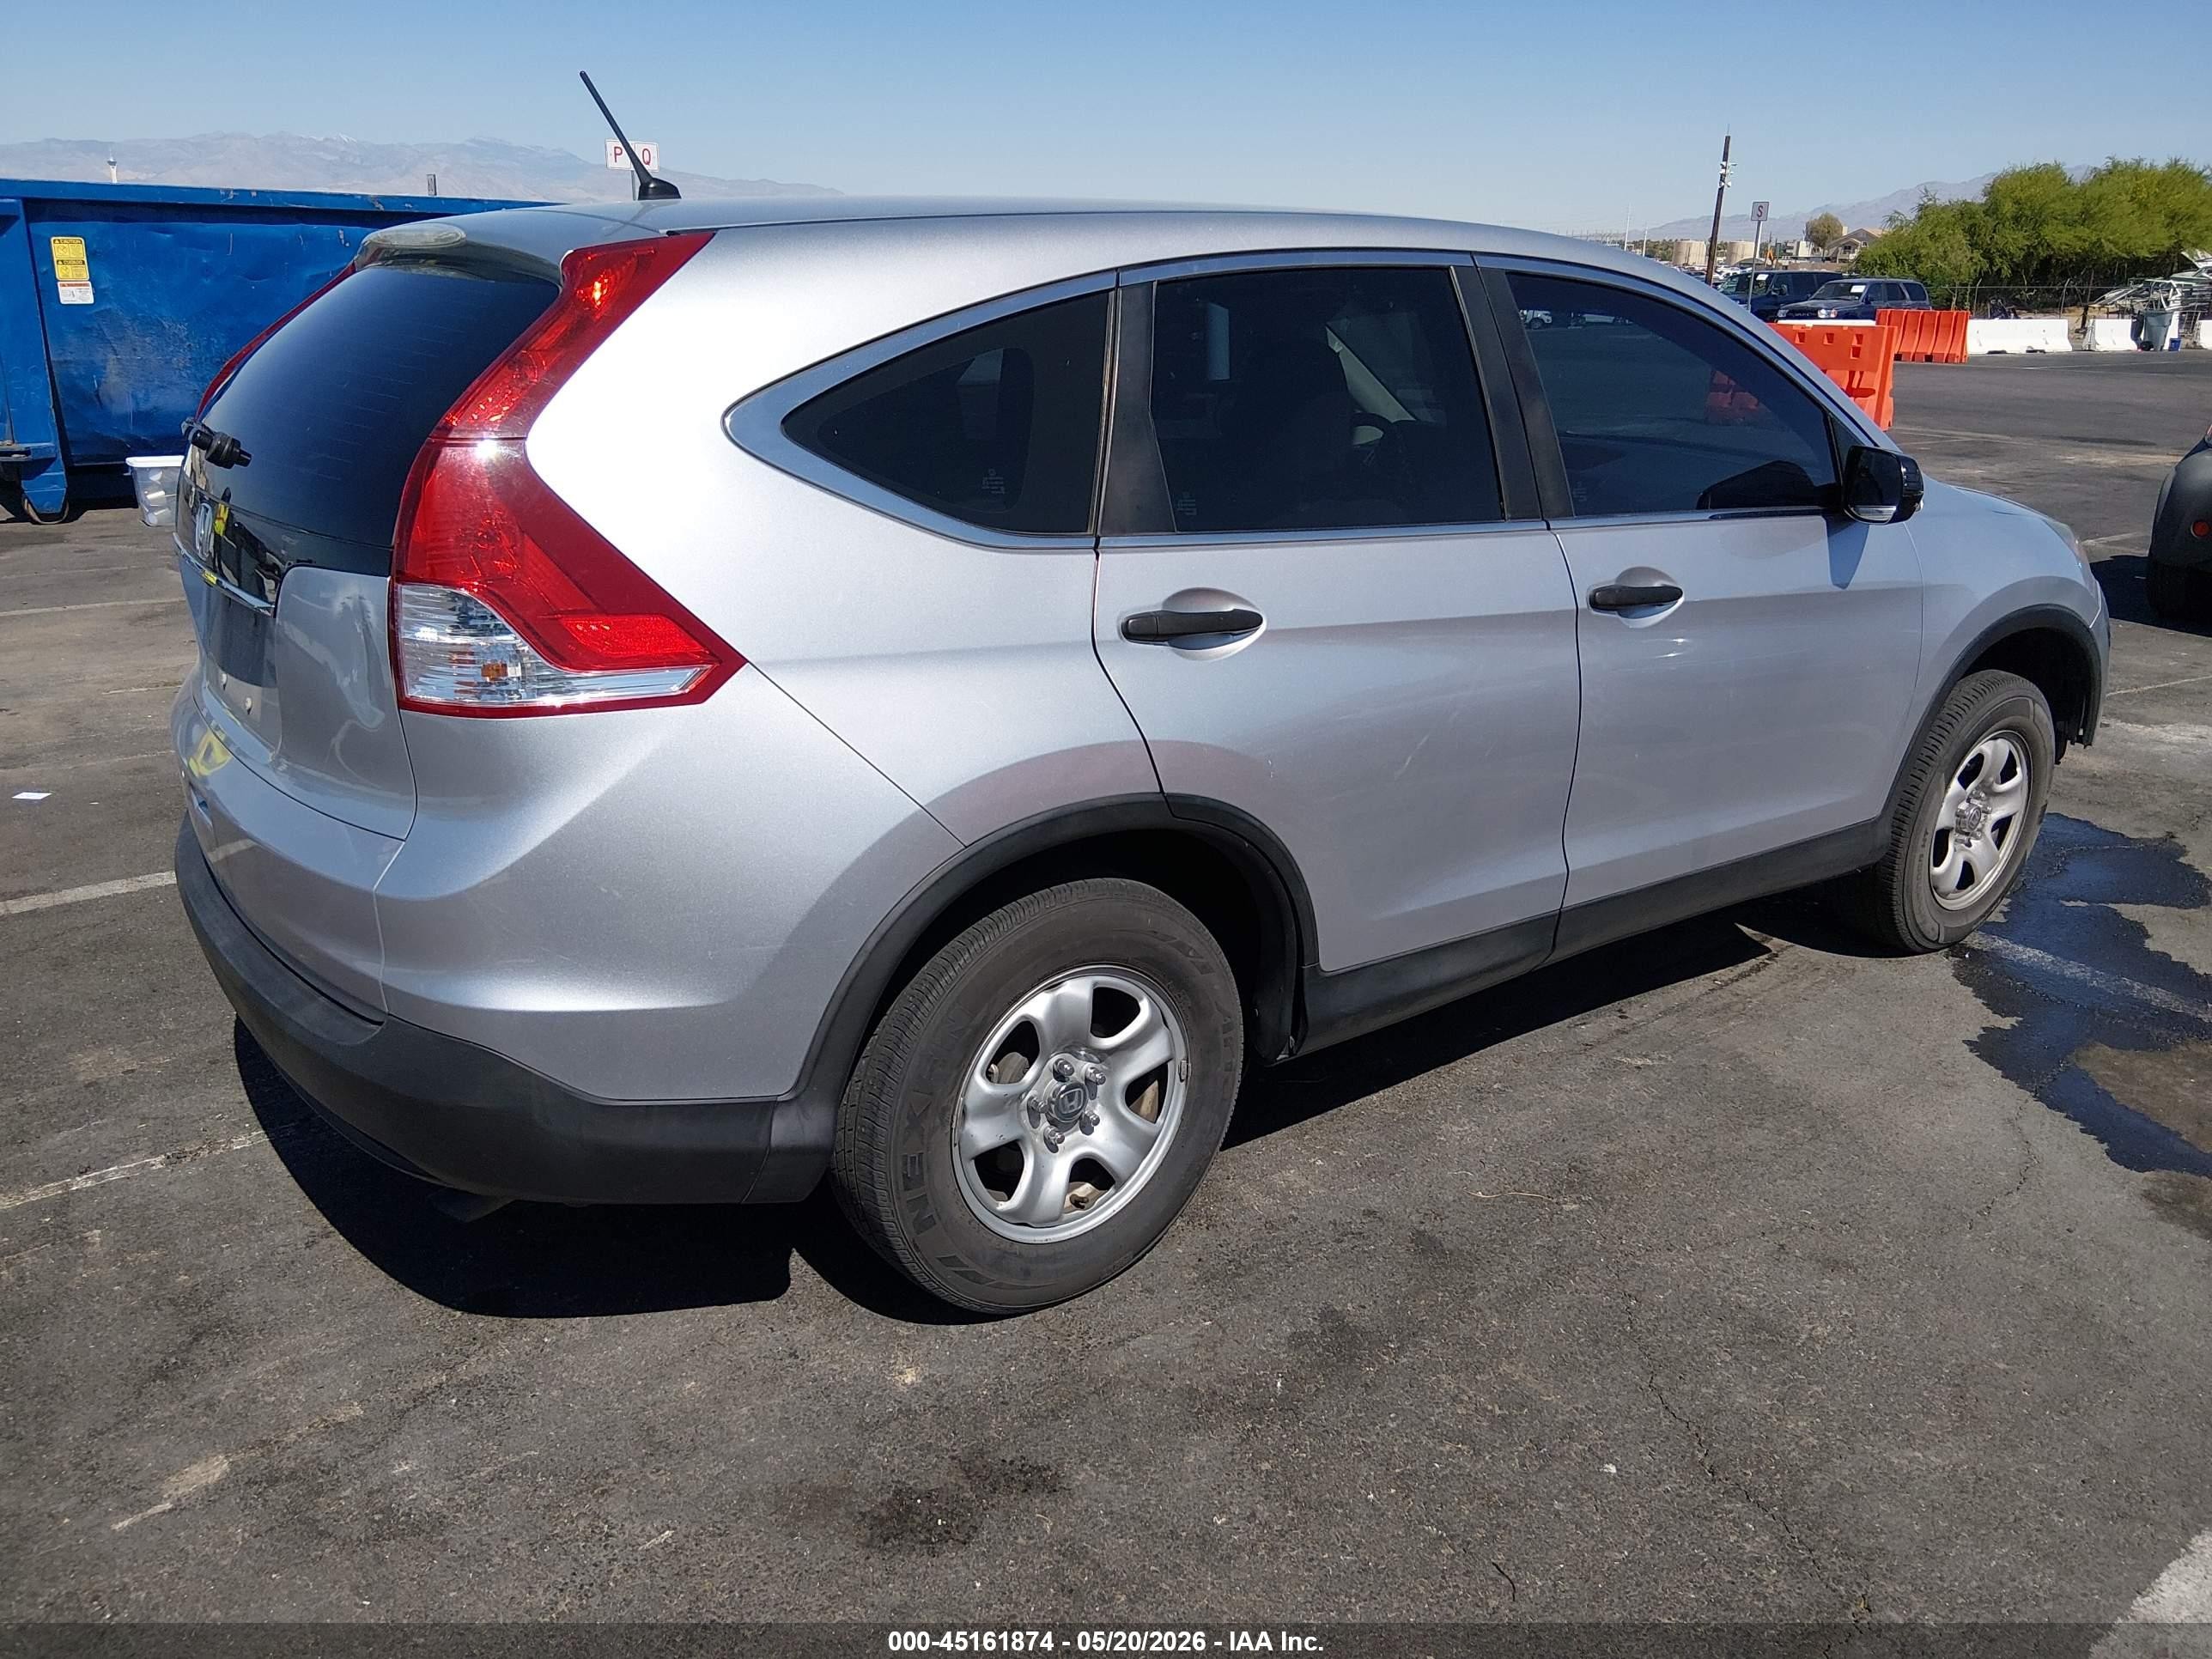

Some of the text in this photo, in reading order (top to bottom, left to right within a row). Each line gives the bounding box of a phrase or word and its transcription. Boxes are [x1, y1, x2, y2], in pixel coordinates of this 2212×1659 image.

[614, 146, 623, 163] P
[642, 148, 652, 166] Q
[1757, 205, 1764, 217] S
